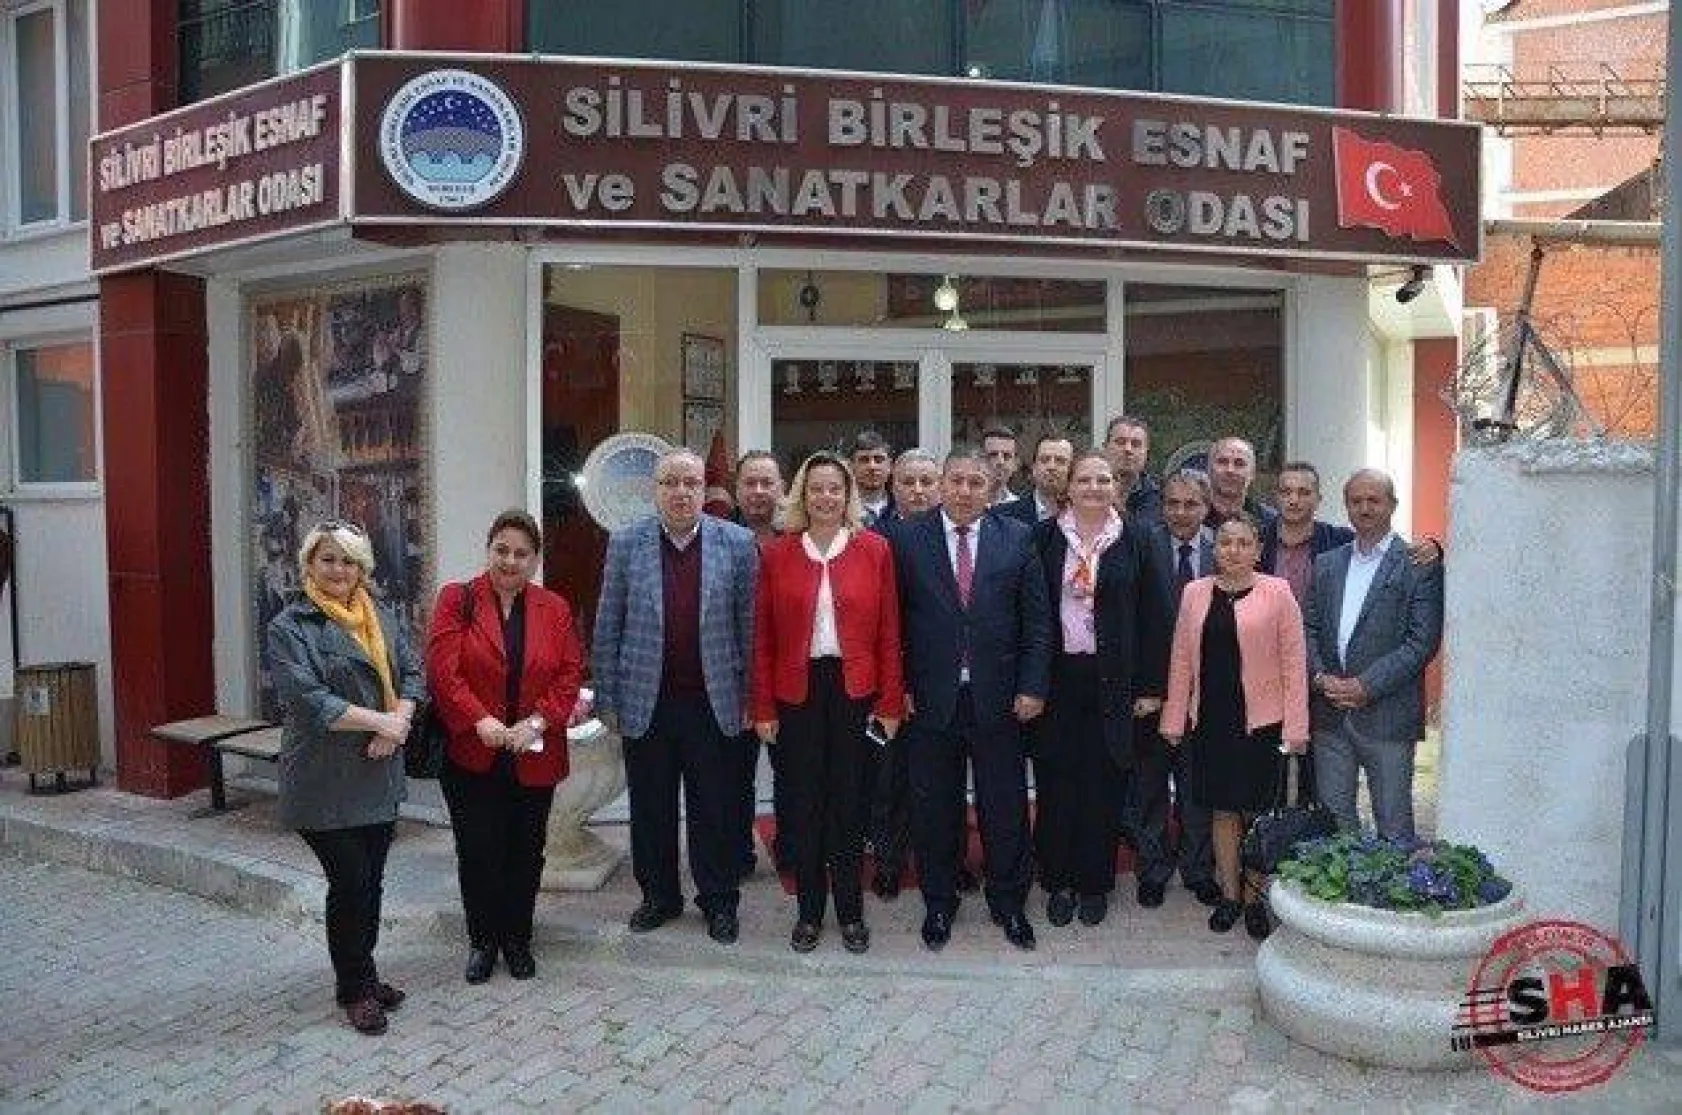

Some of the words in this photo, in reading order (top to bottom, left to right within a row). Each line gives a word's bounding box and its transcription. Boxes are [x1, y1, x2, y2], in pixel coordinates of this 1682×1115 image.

[99, 133, 160, 191] SİLİVRİ
[164, 111, 252, 170] BİRLEŞİK
[254, 94, 327, 150] ESNAF
[563, 77, 798, 142] SİLİVRİ
[828, 88, 1105, 167] BİRLEŞİK
[1132, 119, 1310, 174] ESNAF
[122, 180, 257, 244] SANATKARLAR
[257, 163, 324, 214] ODASI
[563, 173, 635, 211] ve
[659, 164, 1120, 230] SANATKARLAR
[1145, 189, 1310, 242] ODASI
